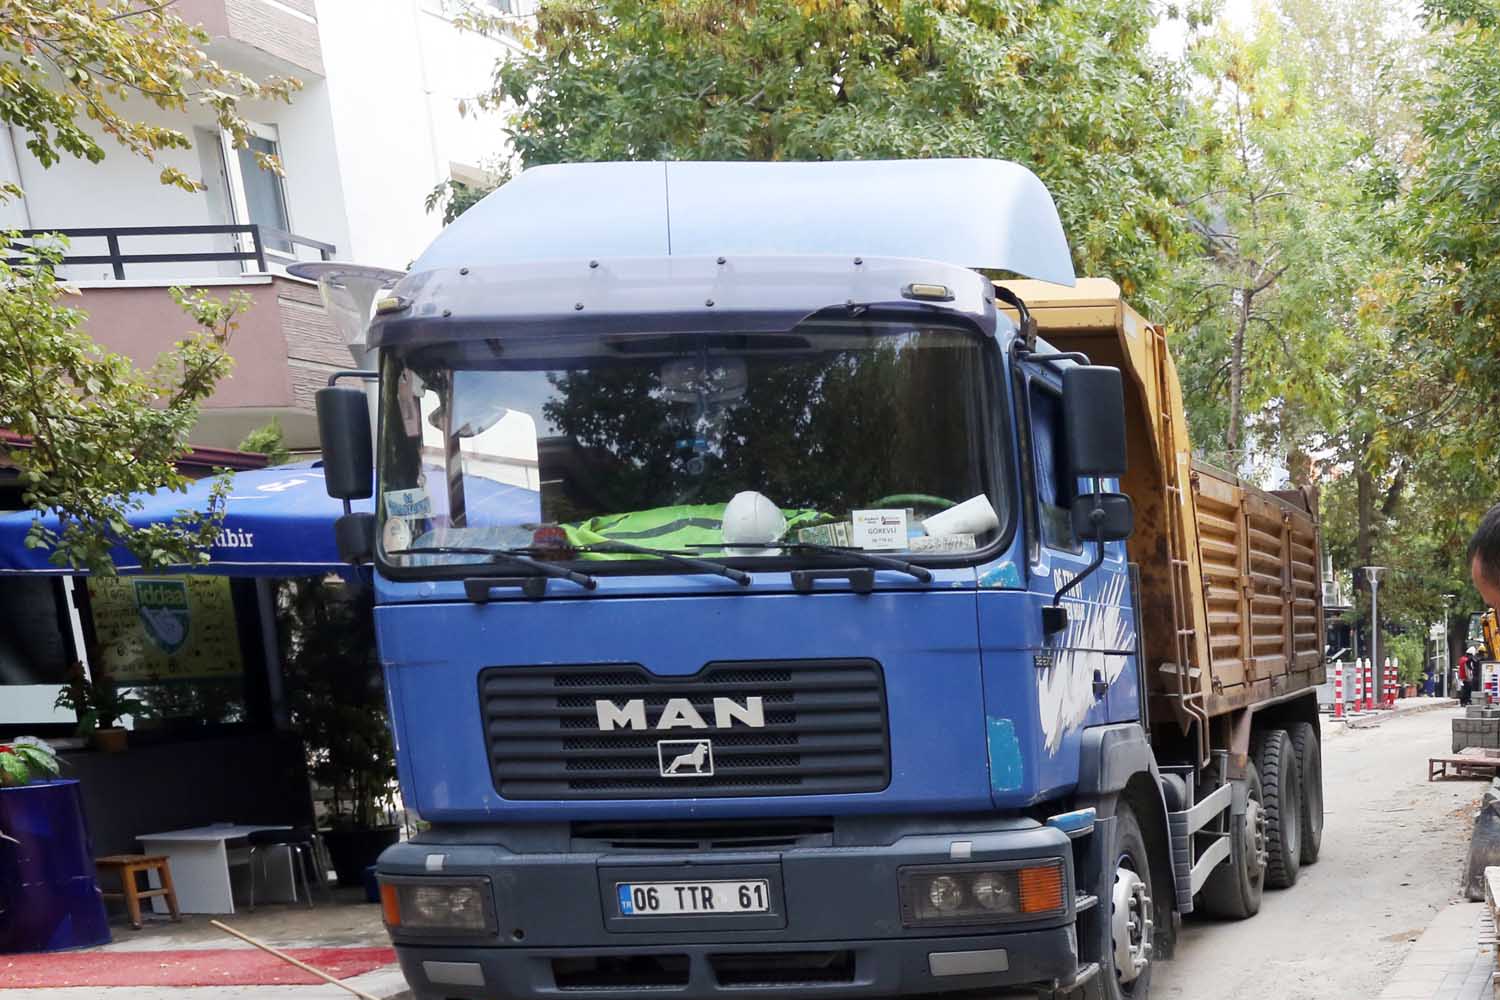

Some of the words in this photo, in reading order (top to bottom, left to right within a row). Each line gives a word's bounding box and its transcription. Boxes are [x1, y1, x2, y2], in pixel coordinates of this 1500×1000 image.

[595, 696, 765, 731] MAN
[633, 886, 660, 911] 06
[674, 886, 714, 910] TTR
[738, 885, 763, 909] 61
